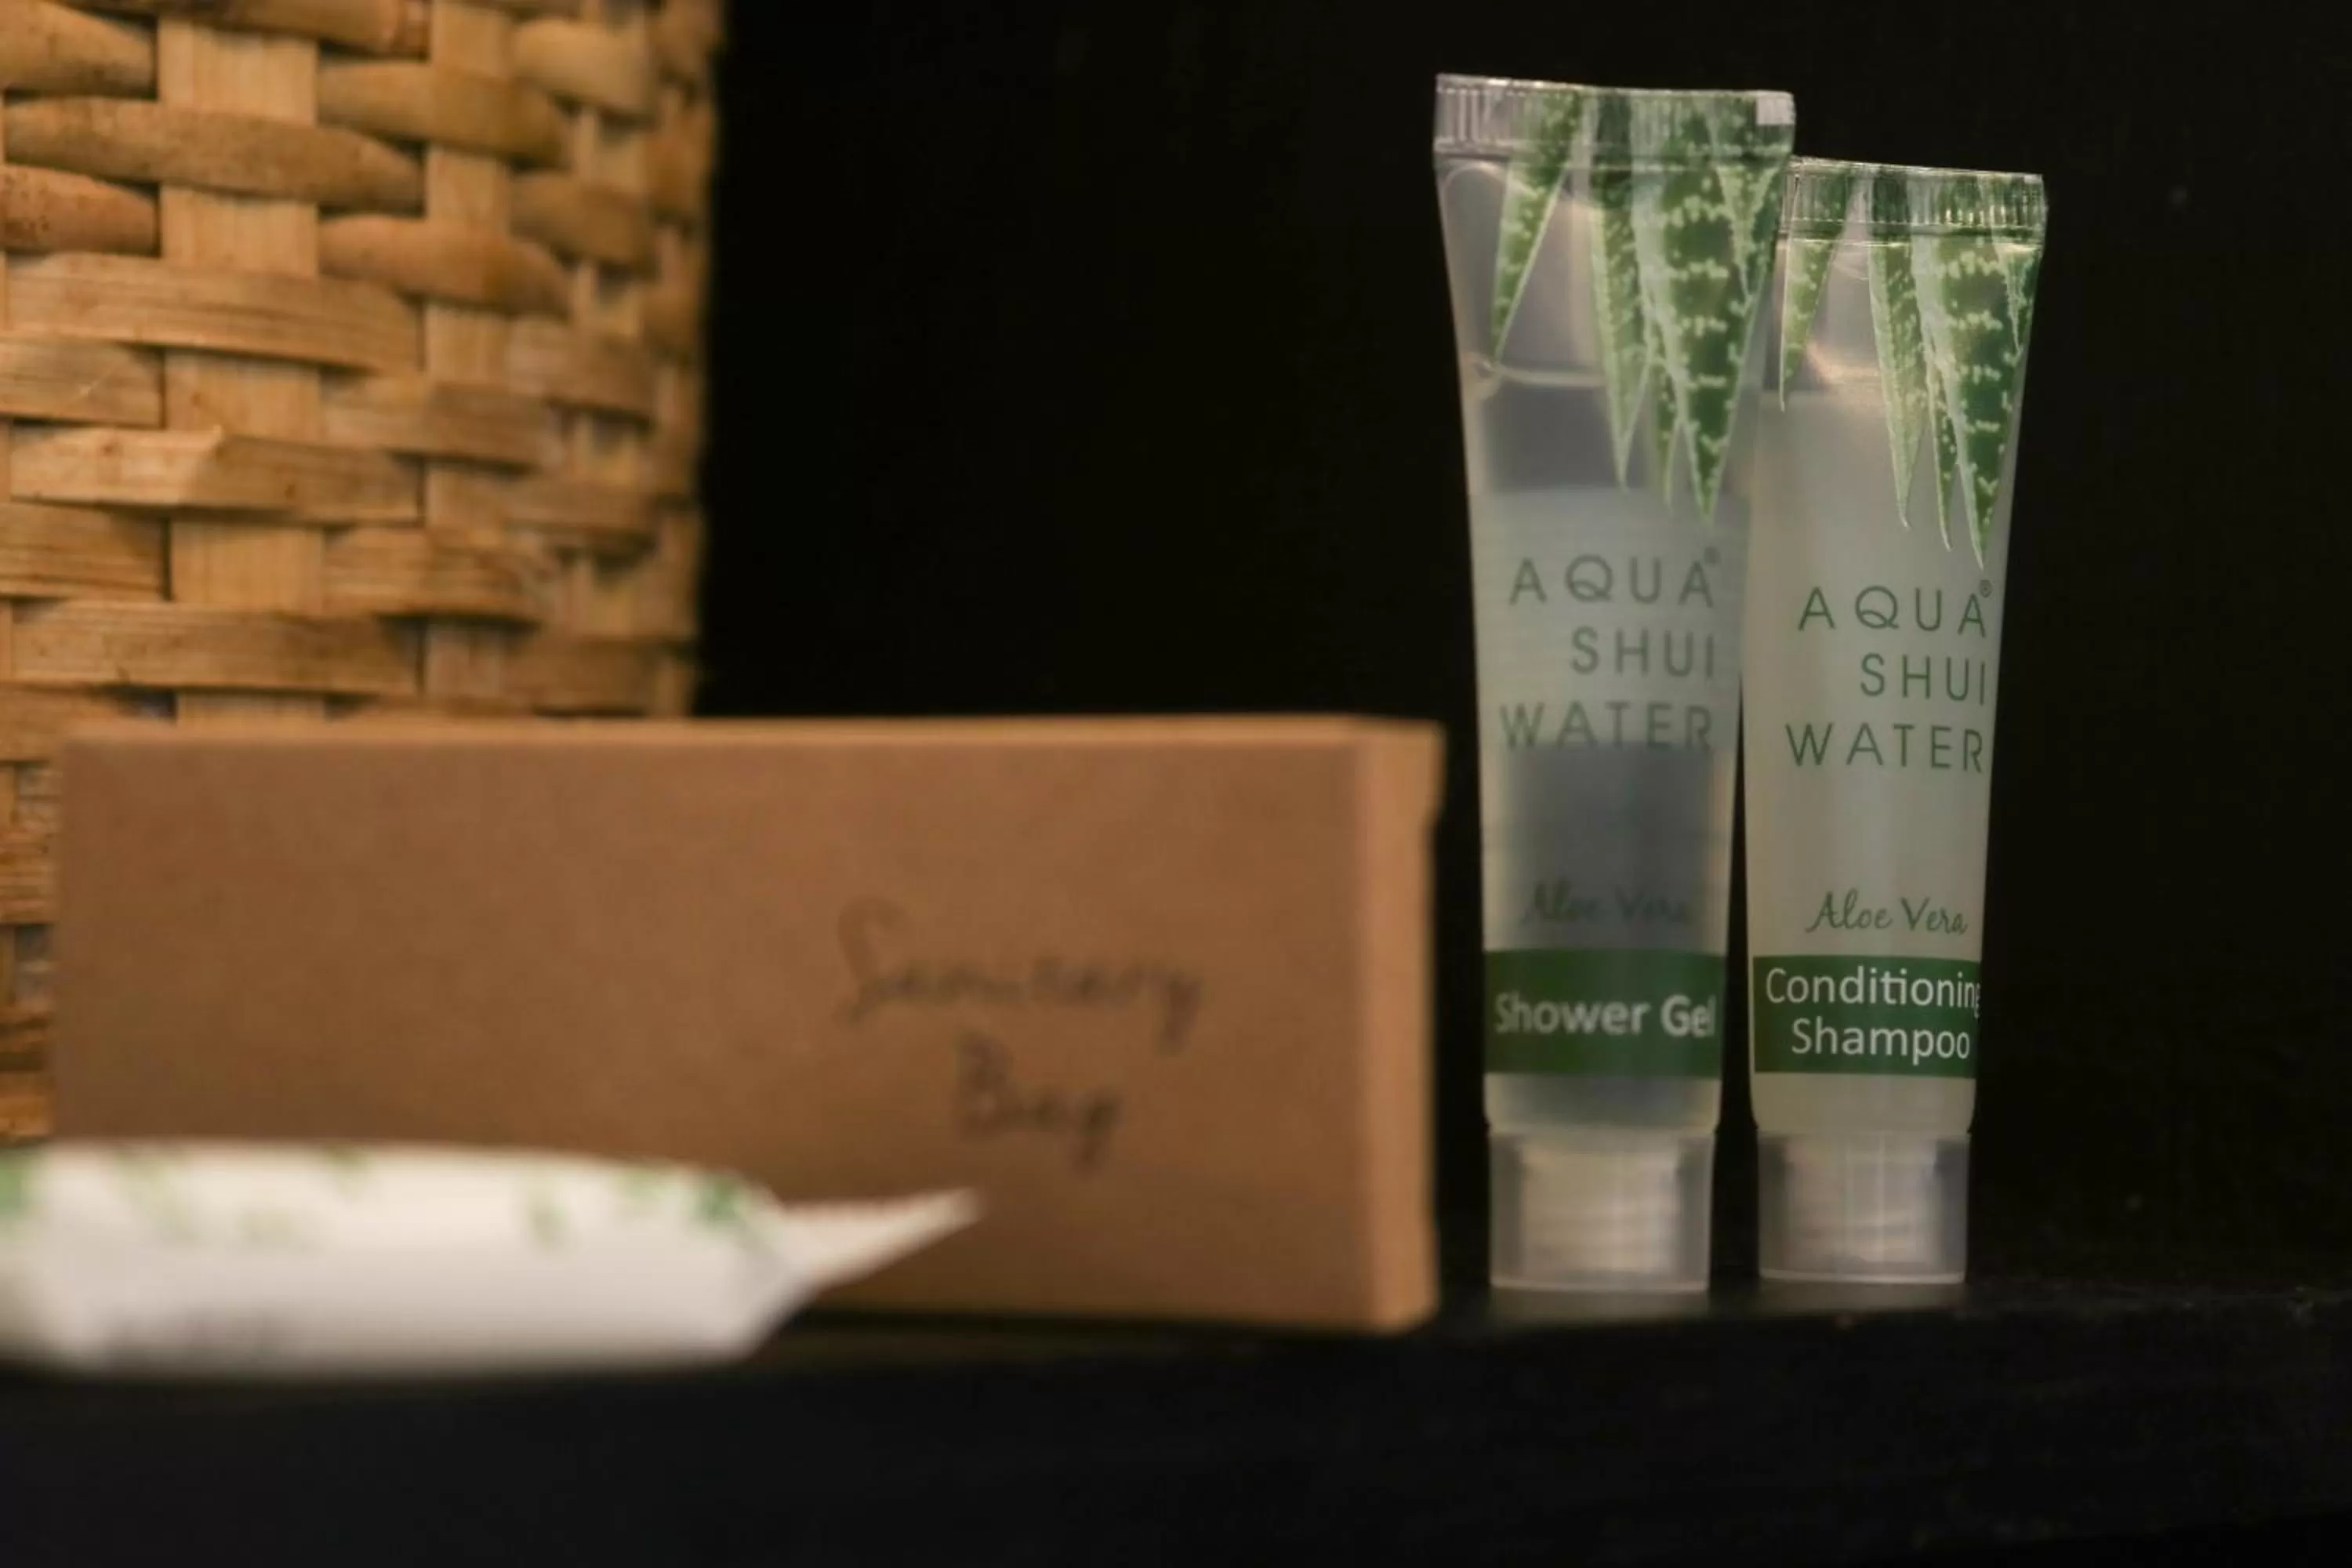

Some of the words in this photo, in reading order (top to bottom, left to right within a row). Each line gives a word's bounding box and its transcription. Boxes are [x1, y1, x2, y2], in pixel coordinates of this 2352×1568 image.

[1571, 625, 1715, 679] SHUI
[1860, 652, 1985, 705] SHUI
[1498, 700, 1712, 750] WATER
[1784, 722, 1983, 774] WATER
[1806, 888, 1893, 933] Aloe
[1900, 897, 1968, 935] Vera
[1495, 991, 1650, 1035] Shower
[1659, 994, 1717, 1038] Gel
[1791, 1016, 1970, 1066] Shampoo
